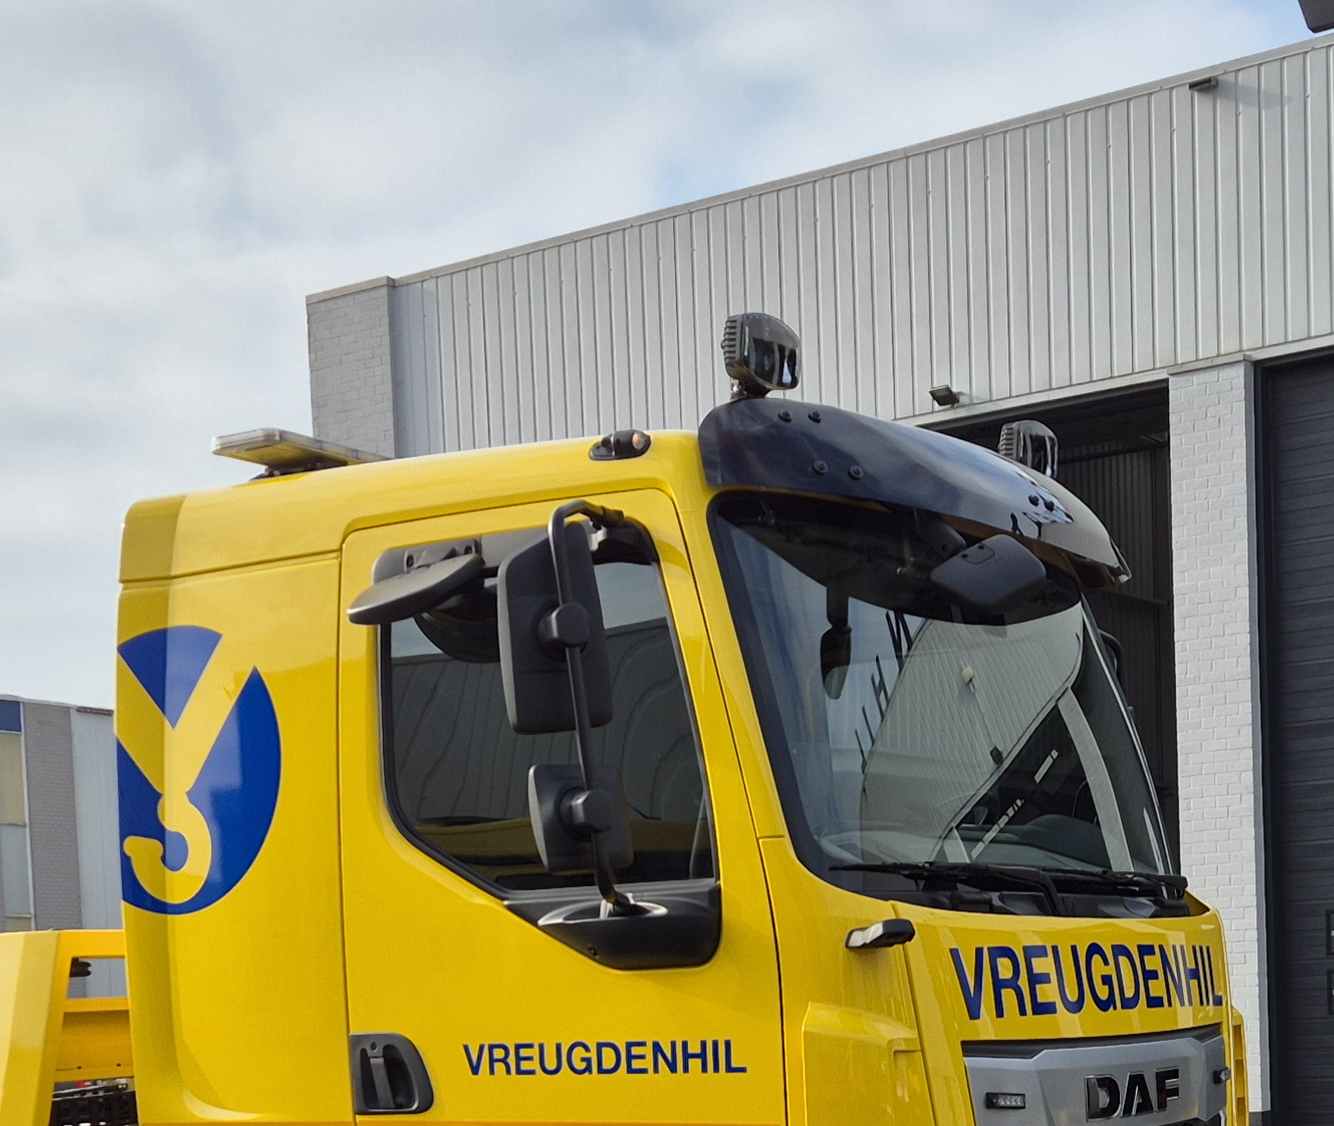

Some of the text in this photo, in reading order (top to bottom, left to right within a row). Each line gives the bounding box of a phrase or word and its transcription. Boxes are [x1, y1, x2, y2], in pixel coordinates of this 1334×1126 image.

[949, 942, 1224, 1020] VREUGDENHIL
[463, 1039, 748, 1076] VREUGDENHIL
[1084, 1065, 1180, 1122] DAF
